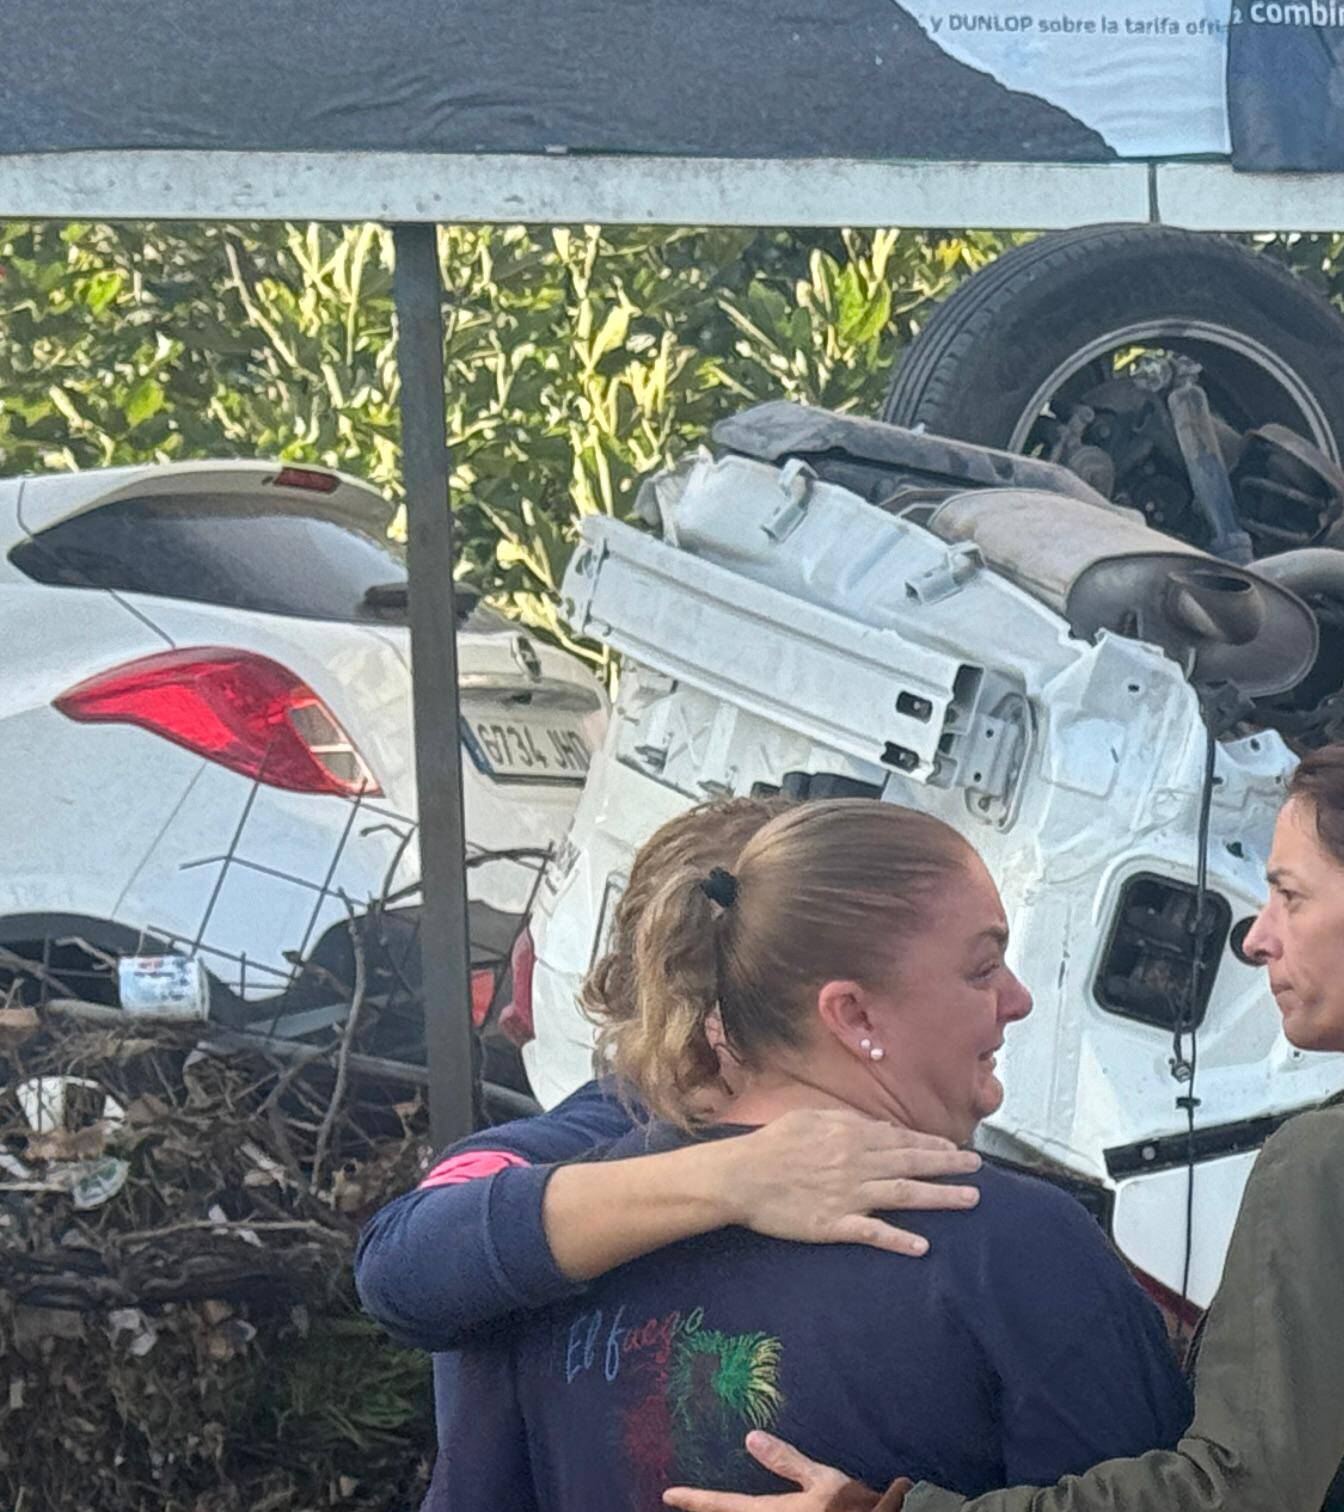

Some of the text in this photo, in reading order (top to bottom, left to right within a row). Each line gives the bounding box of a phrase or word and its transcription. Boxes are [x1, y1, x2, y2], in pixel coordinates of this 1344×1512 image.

[949, 15, 1034, 33] DUNLOP
[1038, 14, 1097, 34] sobre
[1101, 15, 1119, 35] la
[1125, 16, 1181, 35] tarifa
[478, 724, 546, 768] 6734
